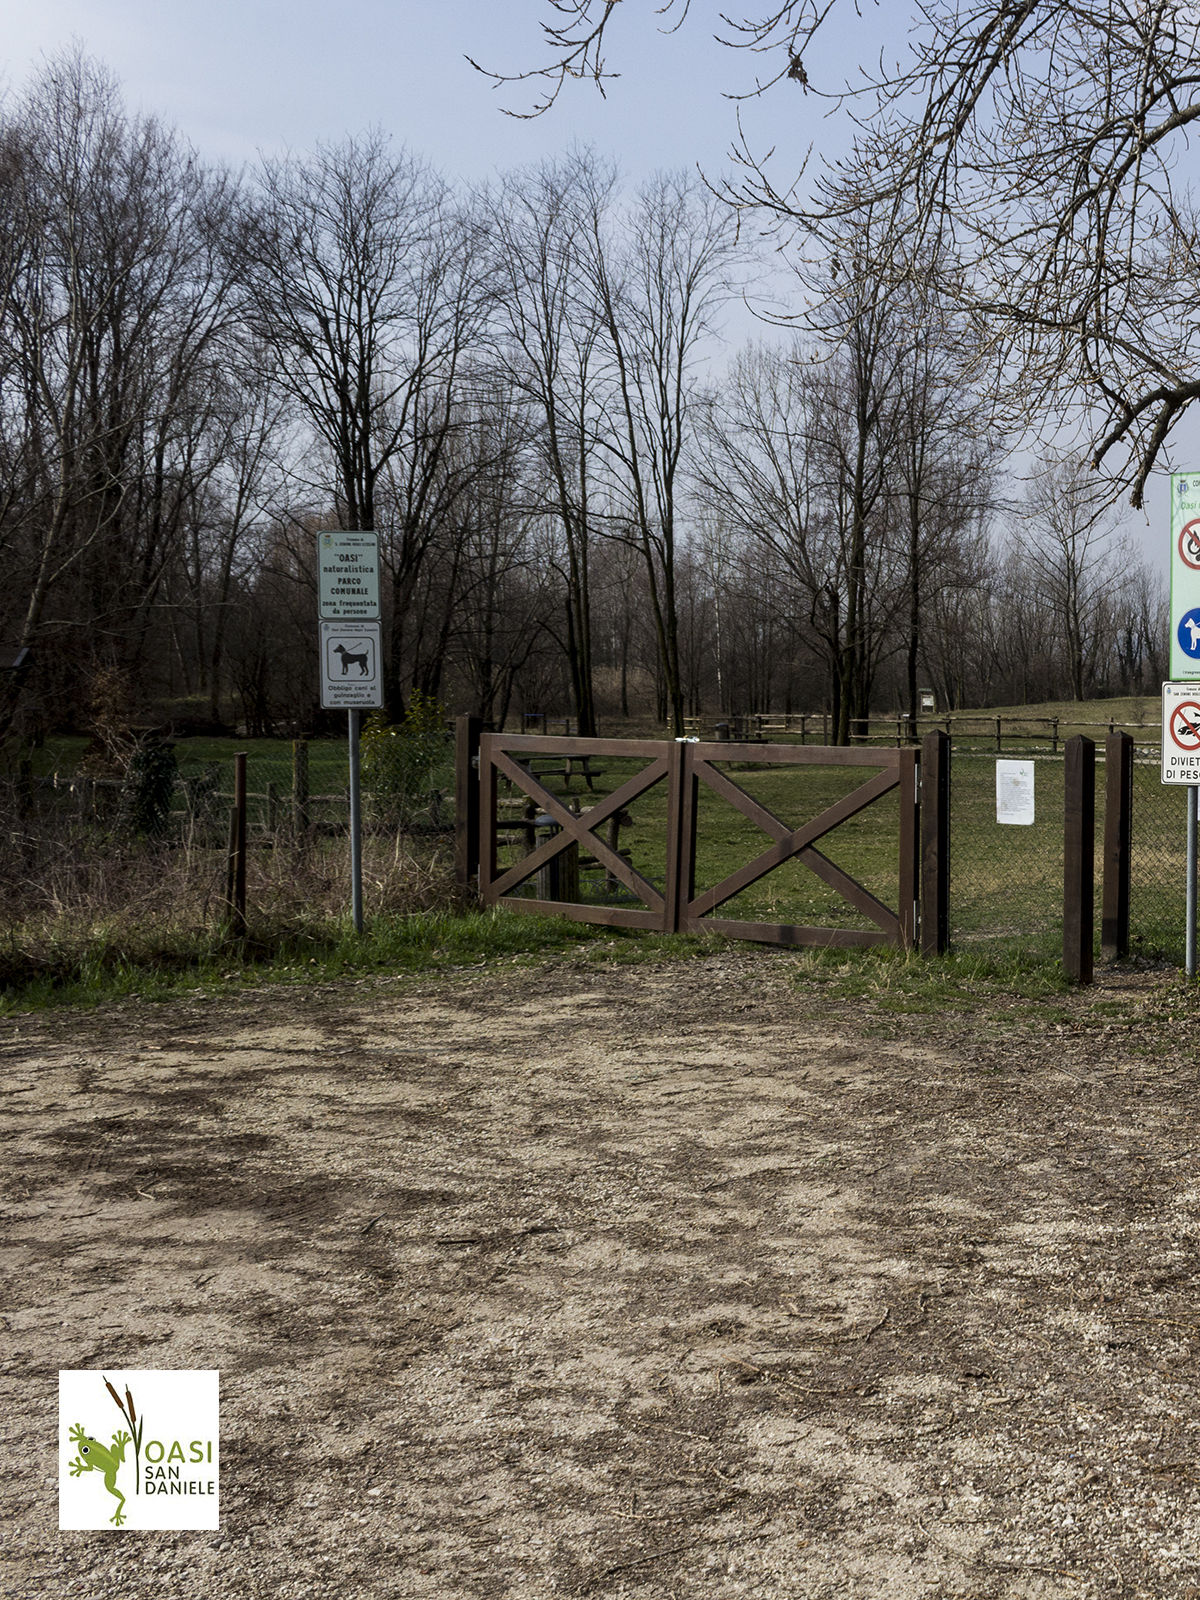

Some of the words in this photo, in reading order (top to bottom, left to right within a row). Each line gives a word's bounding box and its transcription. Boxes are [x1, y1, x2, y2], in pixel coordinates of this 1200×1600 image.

[1181, 502, 1197, 510] Oasi
[323, 565, 374, 573] naturalistica
[337, 577, 361, 585] PARCO
[330, 587, 369, 595] COMUNALE
[1166, 770, 1175, 778] DI
